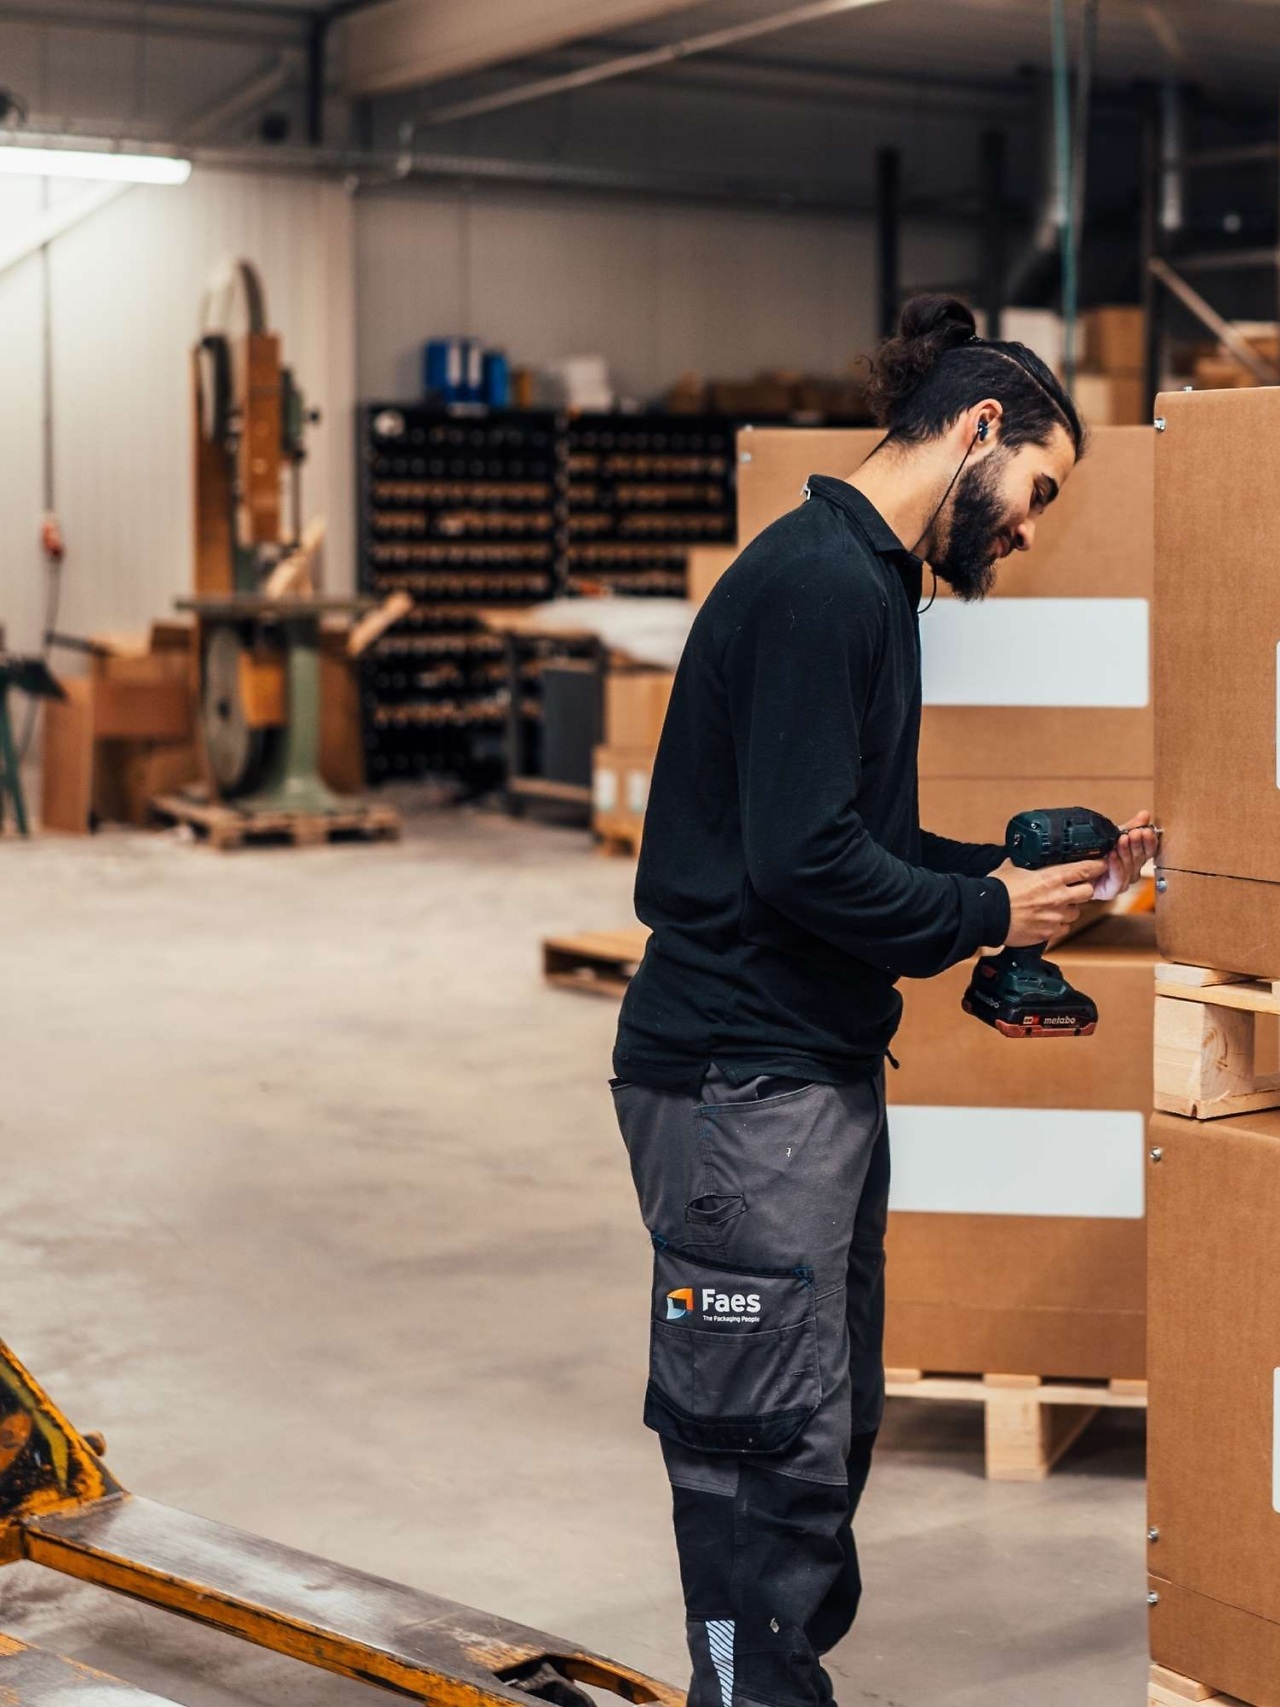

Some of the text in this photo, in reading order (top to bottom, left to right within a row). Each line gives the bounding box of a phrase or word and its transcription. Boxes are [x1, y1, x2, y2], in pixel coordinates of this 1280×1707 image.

[1043, 1015, 1076, 1025] metabo
[702, 1288, 761, 1313] Faes
[713, 1315, 741, 1323] Packaging
